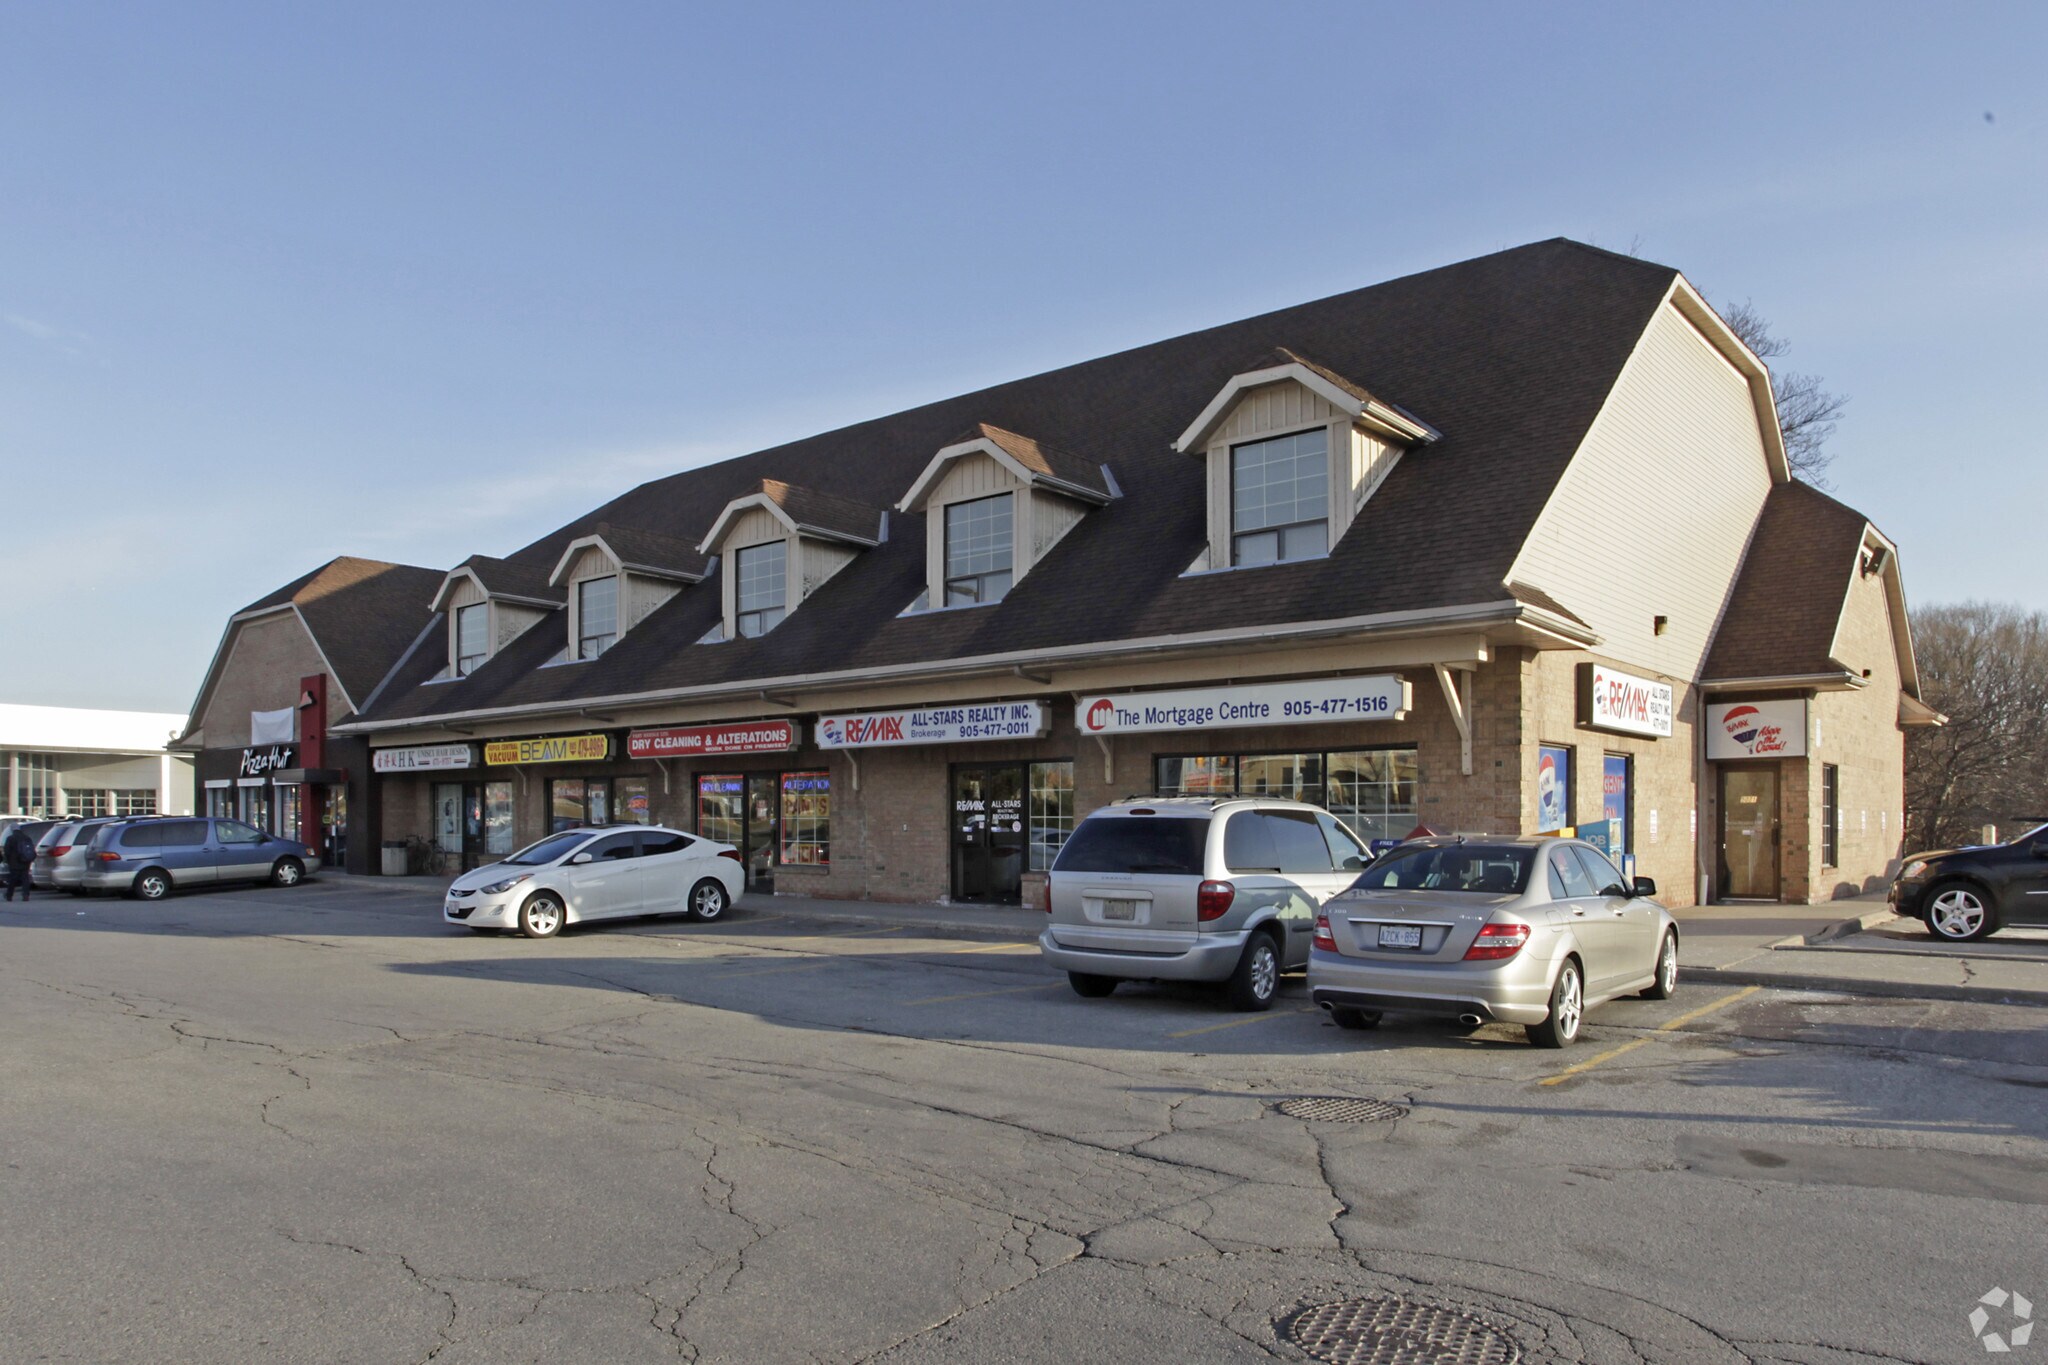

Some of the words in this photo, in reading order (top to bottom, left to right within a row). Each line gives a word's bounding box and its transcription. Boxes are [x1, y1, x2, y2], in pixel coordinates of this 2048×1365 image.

[1116, 709, 1140, 725] The
[1145, 704, 1214, 726] Mortgage
[1219, 701, 1270, 721] Centre
[1283, 696, 1388, 716] 905-477-1516
[1609, 680, 1650, 722] RE/MAX
[911, 710, 964, 726] ALL-STARS
[968, 706, 1007, 722] REALTY
[1011, 704, 1032, 719] INC.
[632, 739, 650, 750] DRY
[654, 736, 701, 749] CLEANING
[705, 735, 712, 746] &
[717, 729, 787, 745] ALTERATIONS
[846, 716, 904, 743] RE/MAX
[911, 728, 946, 738] Brokerage
[960, 722, 1029, 737] 905-477-0011
[1758, 725, 1781, 737] Above
[240, 749, 268, 777] Pizza
[269, 745, 292, 770] Hut
[417, 750, 434, 758] UNISEX
[436, 748, 449, 757] HAIR
[450, 746, 467, 756] DESIGN
[488, 751, 518, 762] VACUUM
[520, 740, 567, 761] BEAM
[956, 800, 985, 811] RE/MAX
[1585, 834, 1606, 846] JOB
[1381, 930, 1400, 943] AZCK
[1404, 931, 1420, 944] 855
